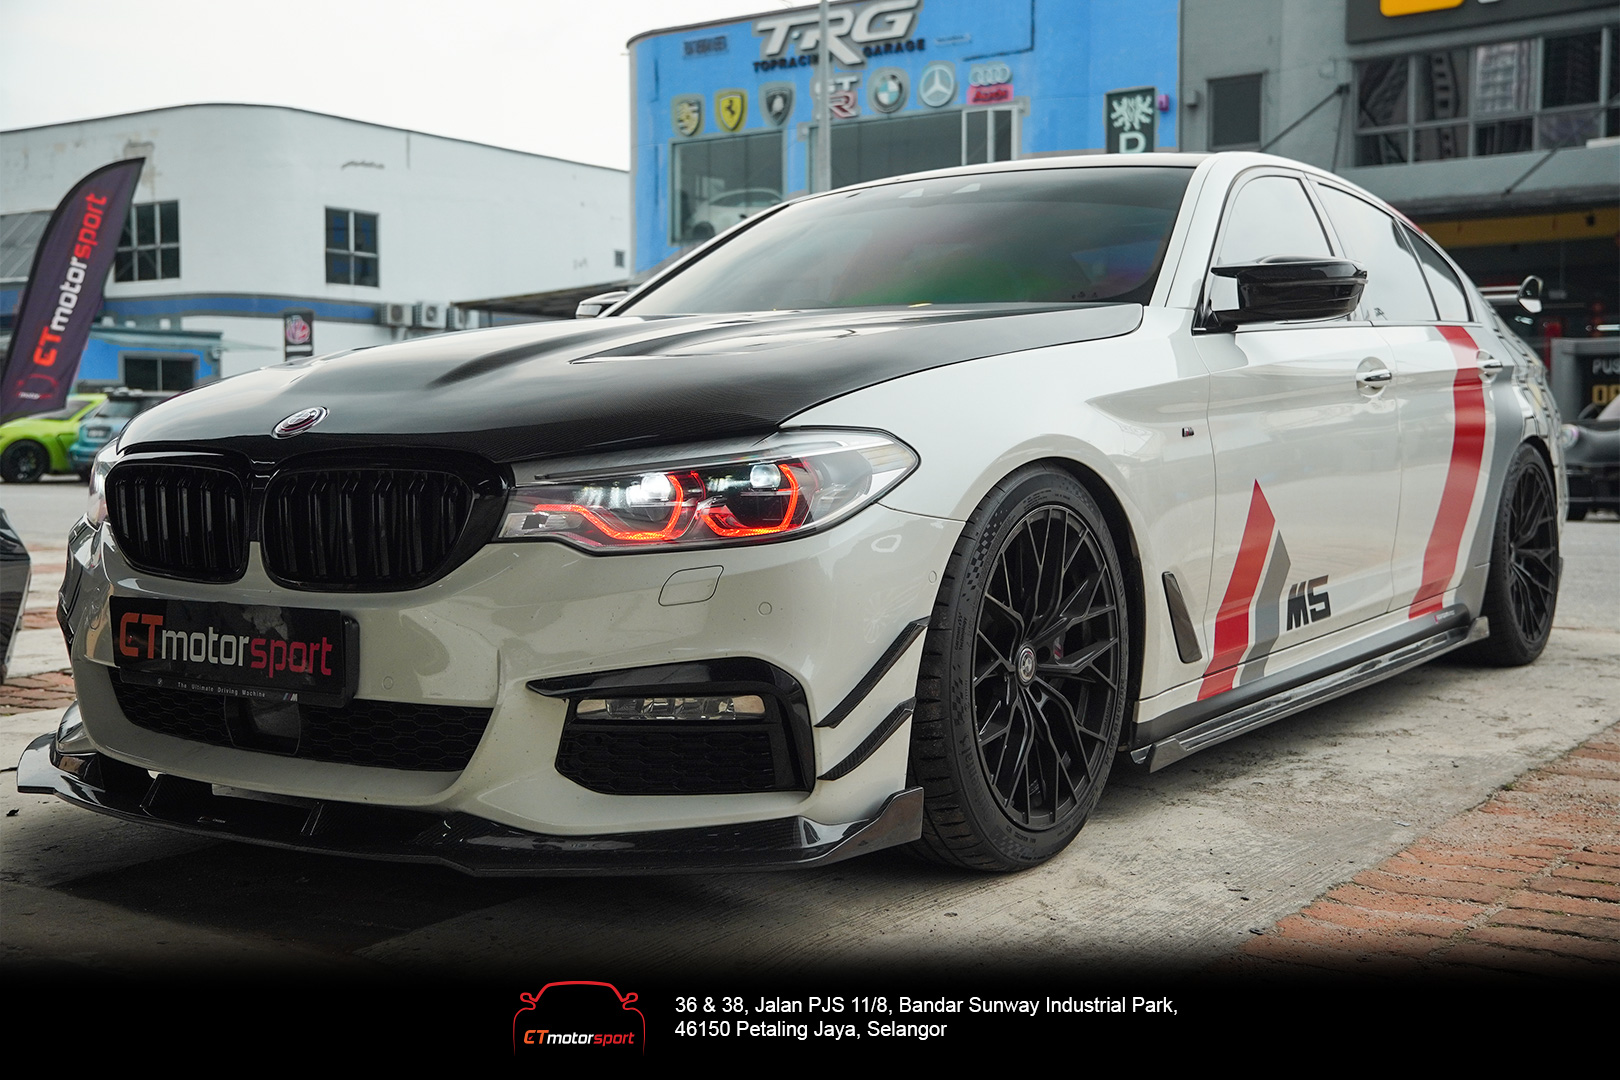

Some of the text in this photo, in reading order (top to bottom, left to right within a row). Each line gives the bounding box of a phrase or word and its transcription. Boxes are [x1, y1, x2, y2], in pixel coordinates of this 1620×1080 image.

[863, 39, 926, 58] GARAGE
[119, 612, 333, 678] CTmotorsport
[217, 686, 239, 696] Driving
